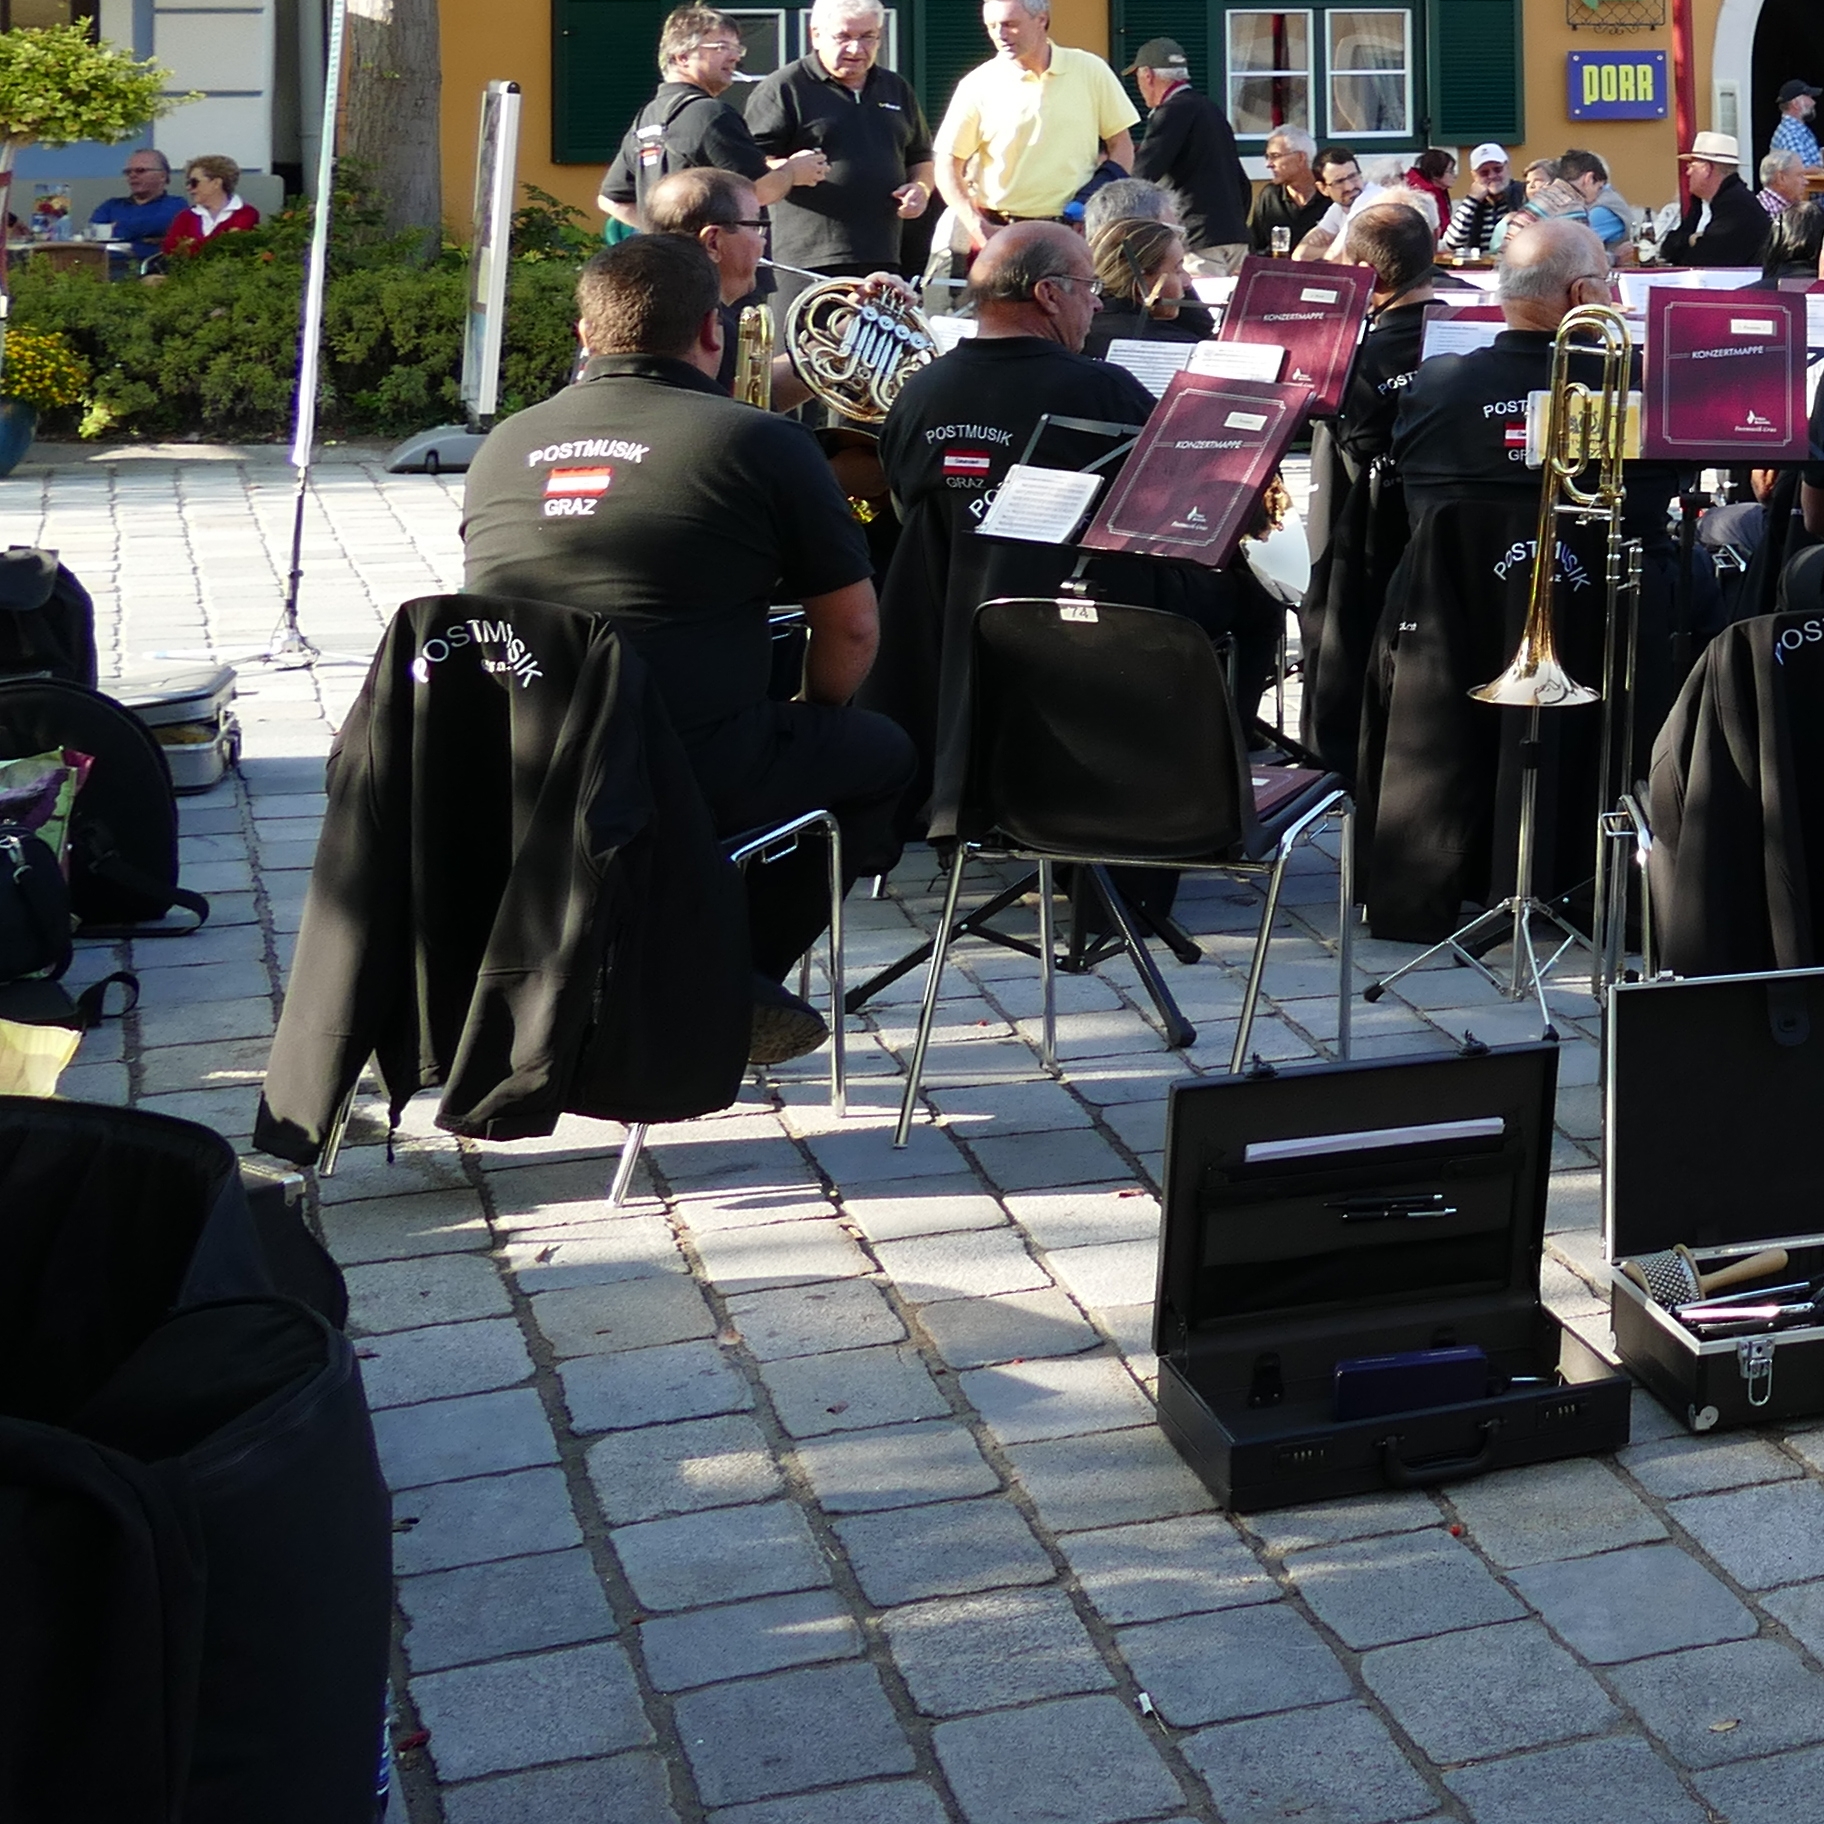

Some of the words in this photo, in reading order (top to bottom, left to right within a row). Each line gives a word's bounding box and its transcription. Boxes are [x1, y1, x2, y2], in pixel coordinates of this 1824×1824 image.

[1583, 65, 1654, 105] PORR
[1263, 313, 1326, 323] KONZERTMAPPE
[1692, 346, 1764, 360] KONZERTMAPPE
[925, 424, 1014, 447] POSTMUSIK
[1174, 440, 1242, 450] KONZERTMAPPE
[528, 439, 650, 468] POSTMUSIK
[945, 476, 986, 489] GRAZ
[543, 497, 597, 516] GRAZ
[1494, 541, 1591, 592] POSTUSIK
